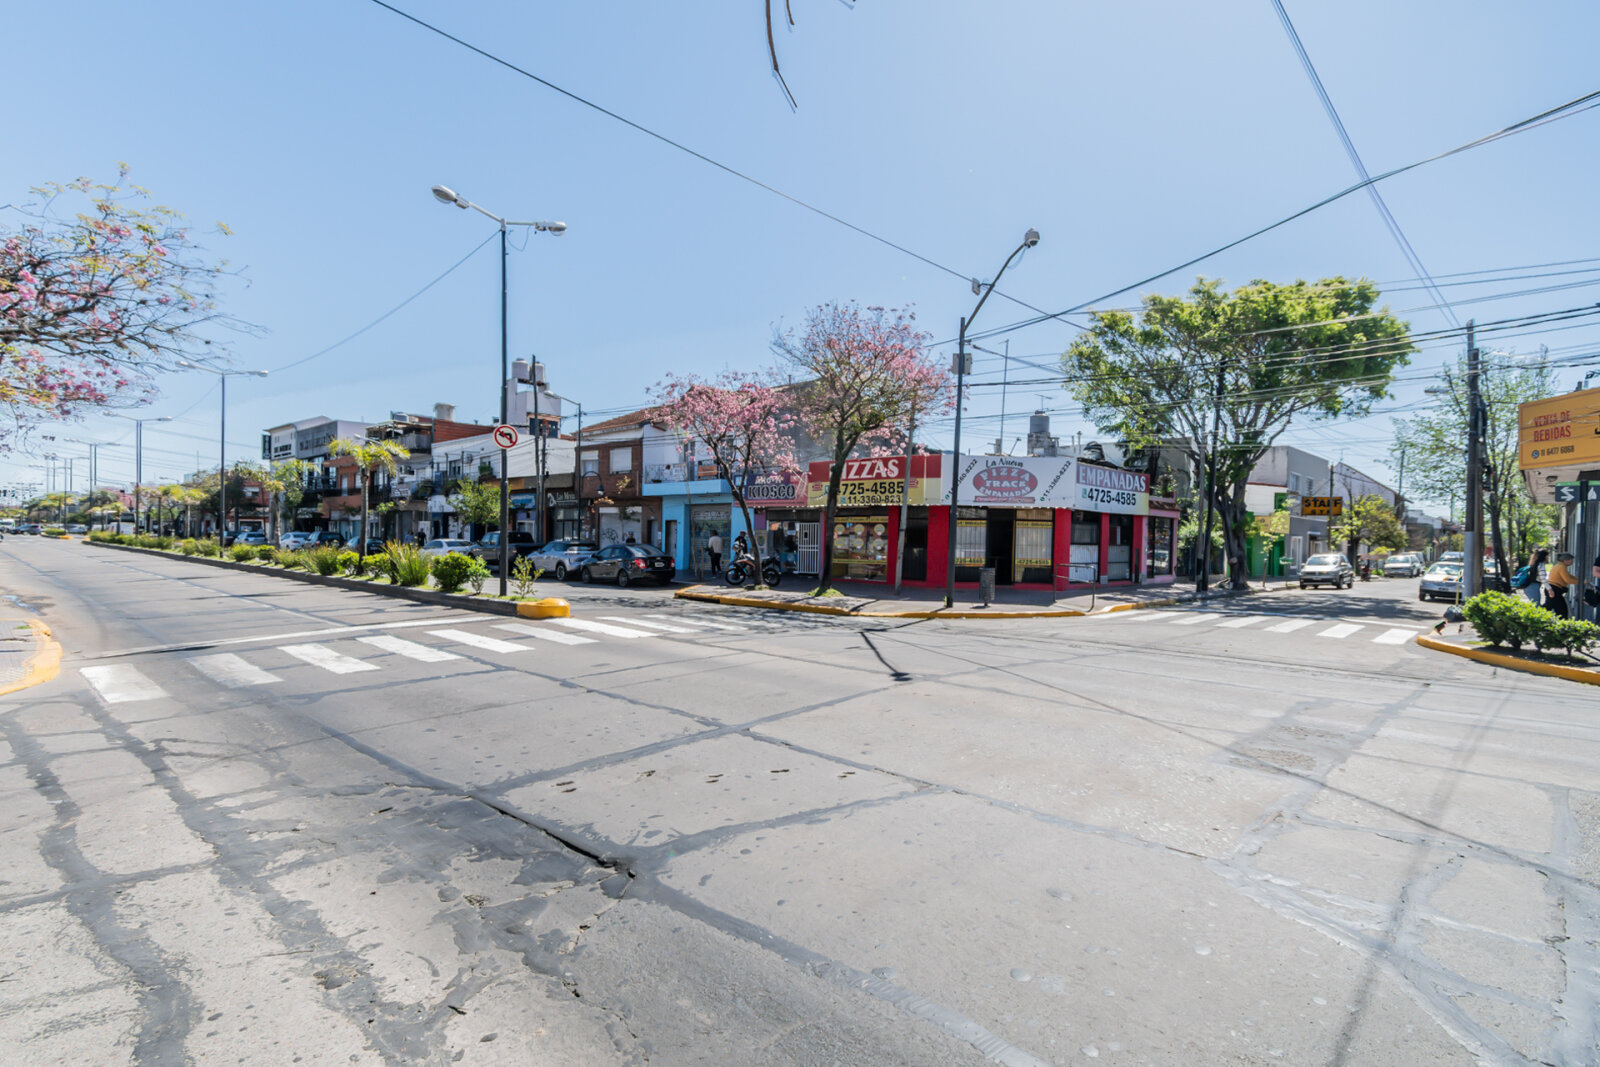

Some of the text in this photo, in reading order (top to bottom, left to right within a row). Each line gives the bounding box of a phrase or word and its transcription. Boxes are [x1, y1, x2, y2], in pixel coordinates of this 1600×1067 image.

[1534, 413, 1558, 426] VENTA
[1533, 425, 1571, 441] BEBIDAS
[829, 459, 899, 479] IZZAS
[978, 467, 1032, 482] PIZZA
[1079, 464, 1146, 492] EMPANADAS
[747, 484, 795, 500] KIOSCO
[837, 481, 904, 495] 725-4585
[978, 485, 1032, 498] EMPANADAS
[847, 494, 903, 505] 11-3360-823
[1087, 488, 1136, 505] 4725-4585
